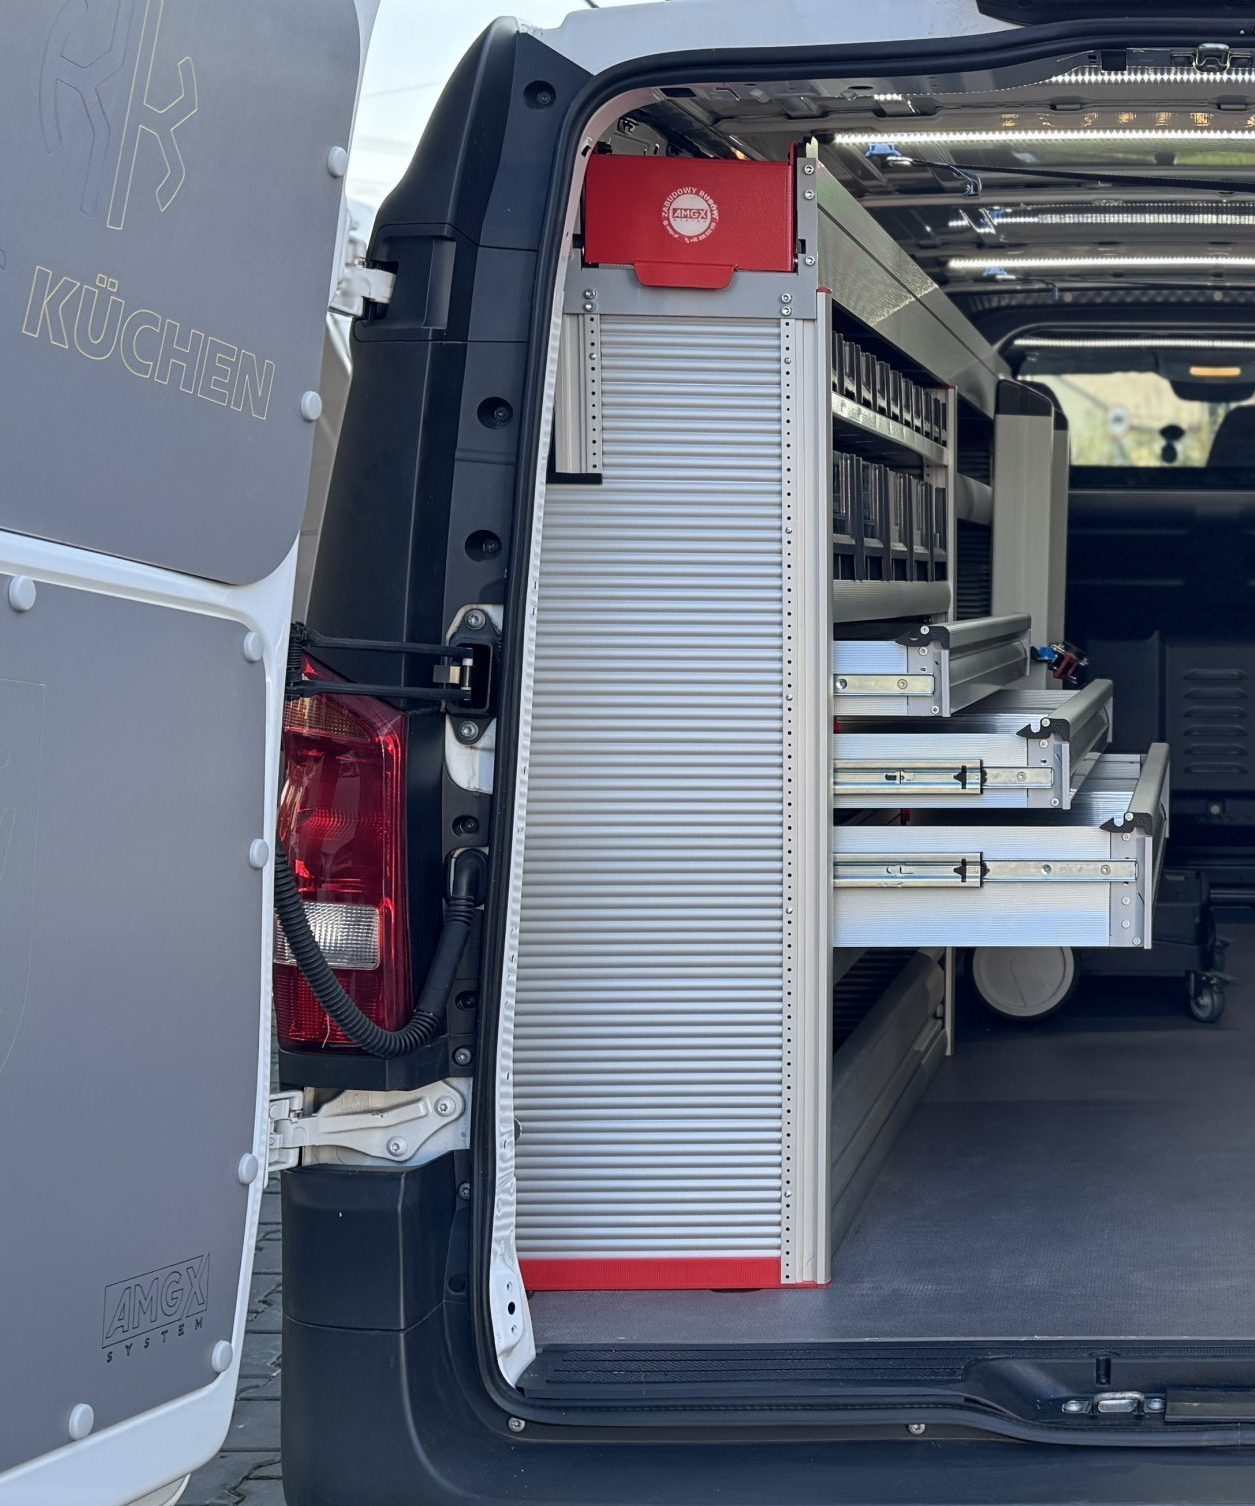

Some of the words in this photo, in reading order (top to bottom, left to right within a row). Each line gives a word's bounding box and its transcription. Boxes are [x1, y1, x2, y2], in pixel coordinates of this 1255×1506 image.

[661, 186, 698, 218] ZABUDOWY
[673, 208, 708, 219] AMGX
[22, 265, 275, 421] KÜCHEN
[105, 1254, 209, 1340] AMGX
[106, 1316, 203, 1364] SYSTEM
